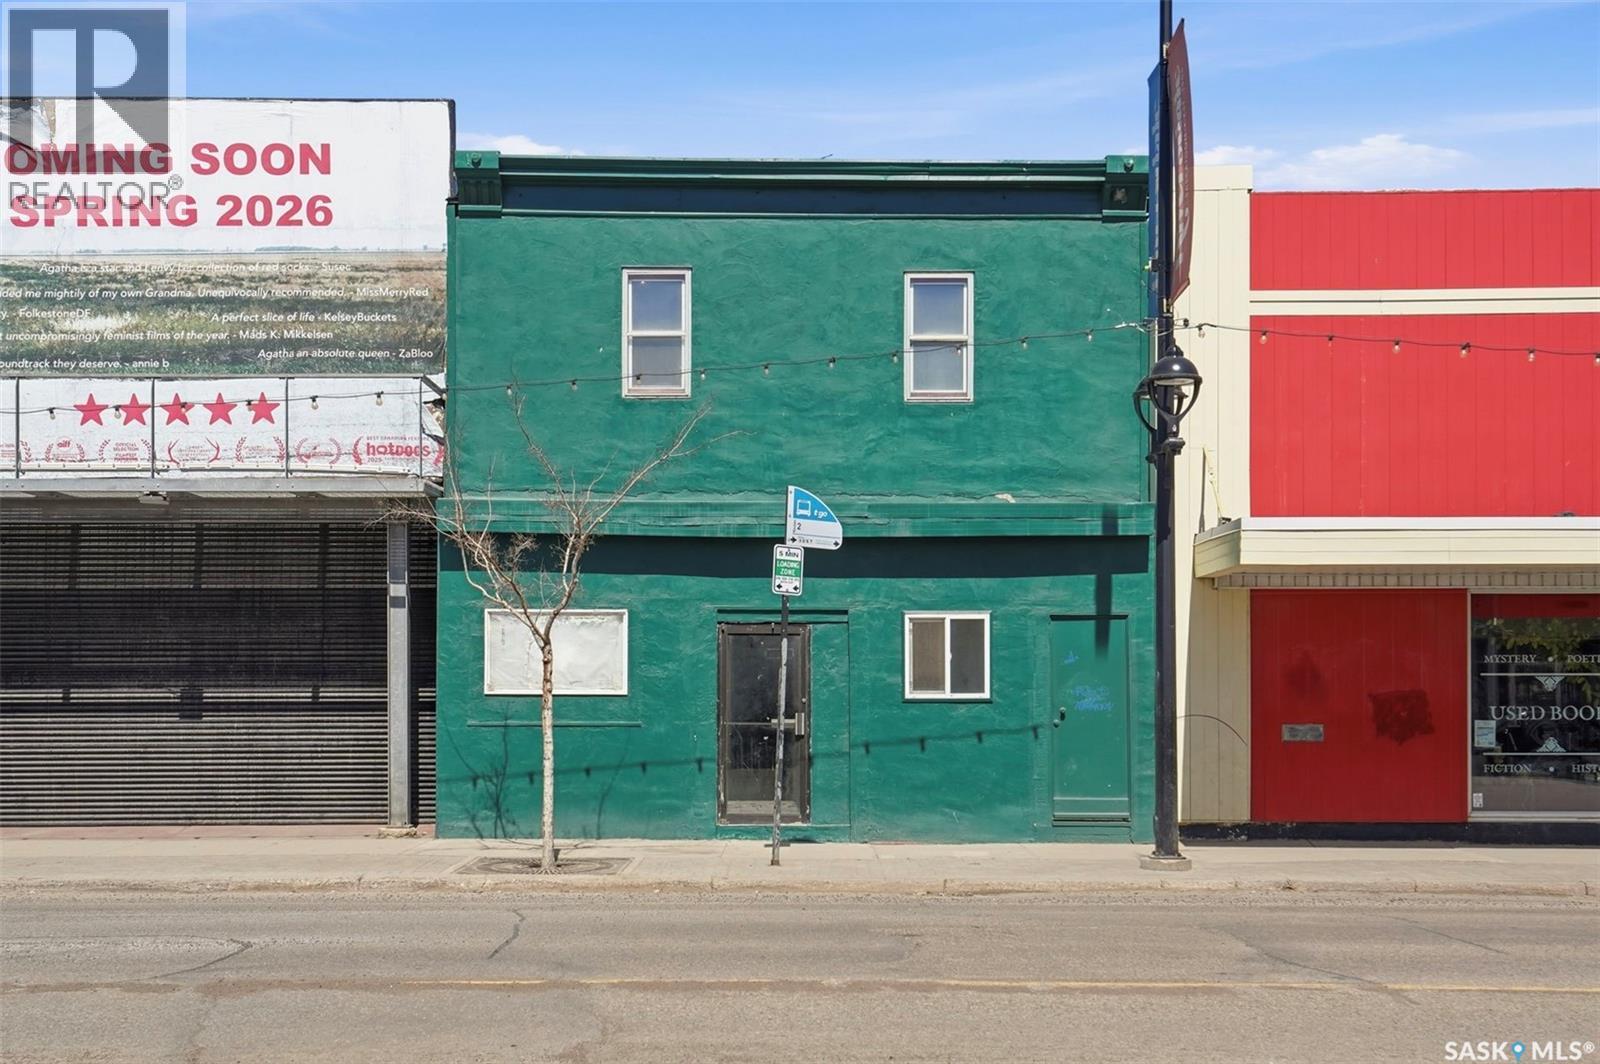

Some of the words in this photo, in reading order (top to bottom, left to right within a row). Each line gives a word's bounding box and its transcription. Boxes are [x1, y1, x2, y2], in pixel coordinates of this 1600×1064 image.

[4, 142, 173, 175] OMING
[190, 142, 331, 175] SOON
[10, 194, 198, 228] SPRING
[216, 194, 334, 228] 2026
[40, 263, 77, 274] Agatha
[25, 290, 42, 298] me
[44, 288, 86, 300] mightily
[88, 288, 100, 298] of
[102, 290, 118, 300] my
[120, 290, 142, 298] own
[198, 287, 268, 300] Unequivocally
[210, 312, 219, 322] A
[221, 312, 259, 324] perfect
[262, 312, 284, 322] slice
[287, 311, 299, 322] of
[300, 311, 315, 322] life
[324, 311, 397, 323] KelseyBuckets
[6, 331, 101, 343] uncompromisingly
[104, 330, 146, 340] feminist
[147, 329, 171, 340] films
[173, 330, 185, 340] of
[187, 330, 204, 340] the
[283, 329, 334, 339] Mikkelsen
[257, 348, 295, 360] Agatha
[296, 350, 309, 358] an
[311, 348, 355, 358] absolute
[357, 350, 390, 360] queen
[398, 348, 434, 358] ZaBloo
[0, 358, 50, 369] oundtrack
[53, 358, 77, 370] they
[132, 358, 160, 369] annie
[162, 358, 170, 369] b
[796, 522, 802, 530] 2
[776, 560, 800, 569] LOADING
[780, 568, 796, 576] ZONE
[1484, 654, 1537, 664] MYSTERY
[1489, 705, 1545, 721] USED
[1550, 705, 1600, 721] BOO
[1483, 763, 1532, 773] FICTION
